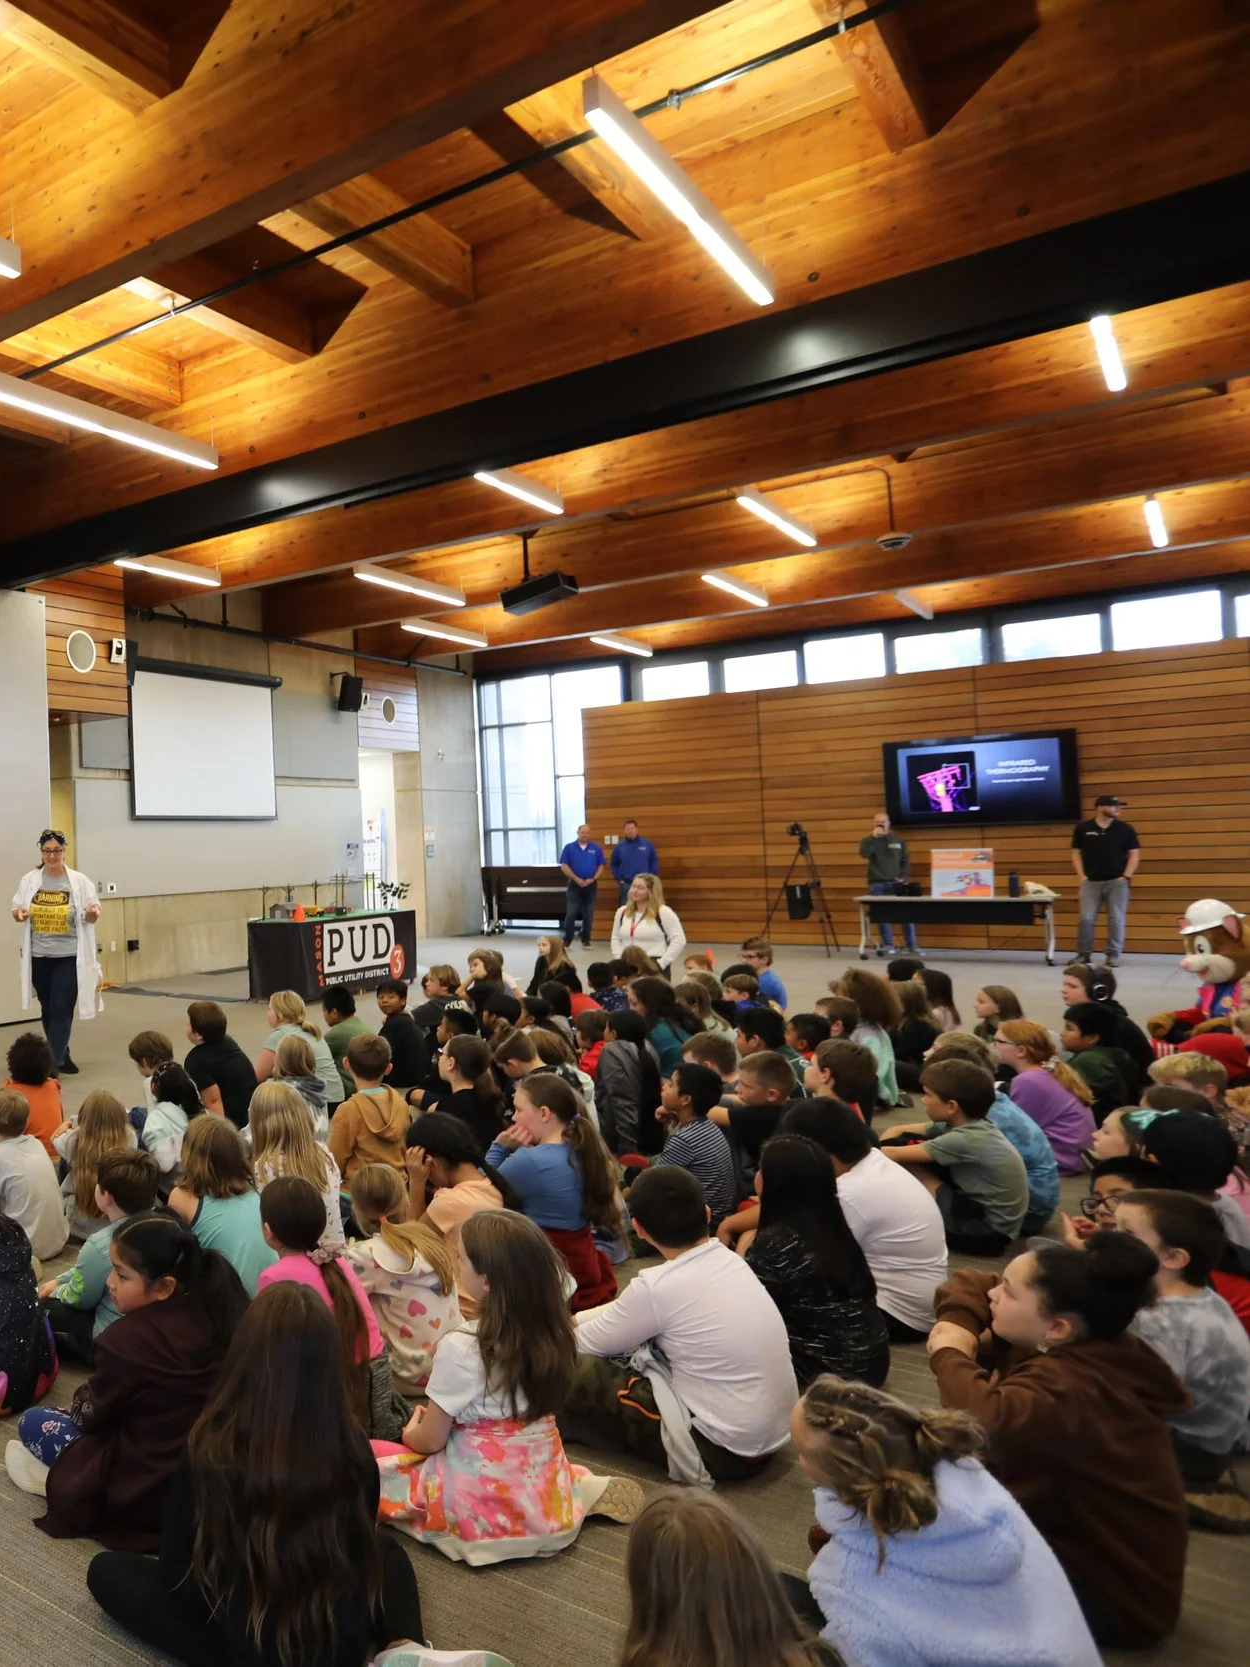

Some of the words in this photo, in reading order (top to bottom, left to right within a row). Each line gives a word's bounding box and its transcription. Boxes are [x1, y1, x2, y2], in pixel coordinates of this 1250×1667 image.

[38, 893, 64, 903] WARNING
[328, 923, 391, 967] PUD
[393, 949, 402, 975] 3
[325, 975, 344, 986] PUBLIC
[344, 971, 365, 982] UTILITY
[364, 967, 390, 978] DISTRICT
